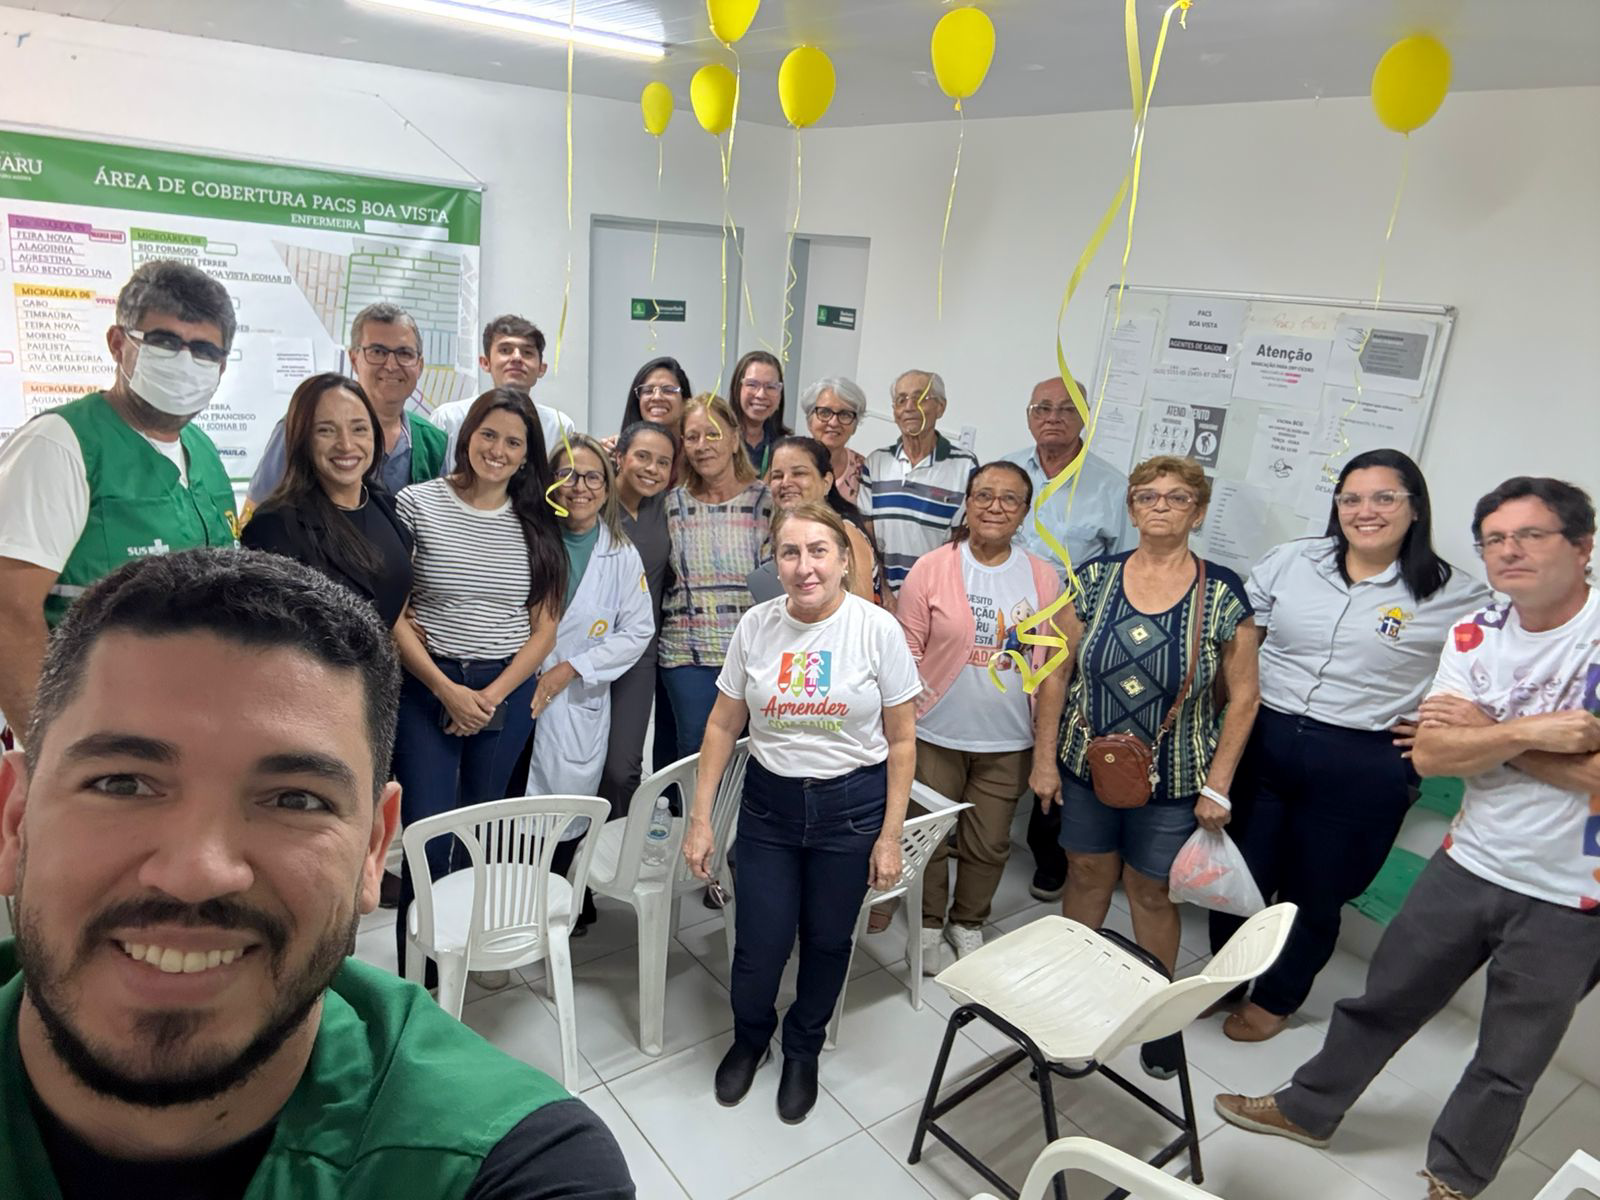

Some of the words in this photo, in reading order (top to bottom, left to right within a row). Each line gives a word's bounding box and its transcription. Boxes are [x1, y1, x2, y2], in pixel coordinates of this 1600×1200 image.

[0, 155, 43, 175] ARU
[94, 166, 152, 191] ÁREA
[158, 177, 186, 195] DE
[191, 181, 307, 209] COBERTURA
[312, 194, 356, 213] PACS
[361, 200, 397, 219] BOA
[400, 205, 449, 224] VISTA
[291, 214, 360, 230] ENFERMEIRA
[17, 231, 44, 240] FEIRA
[47, 233, 74, 243] NOVA
[18, 242, 75, 254] ALAGOINHA
[138, 243, 154, 251] RIO
[155, 245, 198, 255] FORMOSO
[19, 253, 73, 265] AGRESTINA
[19, 262, 39, 272] SÃO
[42, 266, 73, 275] BENTO
[75, 268, 90, 276] DO
[92, 268, 113, 279] UNA
[224, 271, 249, 281] VISTA
[22, 287, 77, 298] MICROÁREA
[22, 299, 48, 308] CABO
[1197, 309, 1212, 318] PACS
[25, 321, 51, 330] FEIRA
[54, 322, 81, 331] NOVA
[1188, 320, 1200, 328] BOA
[1200, 321, 1218, 329] VISTA
[26, 332, 66, 340] MORENO
[27, 342, 71, 351] PAULISTA
[1170, 340, 1194, 350] AGENTES
[64, 354, 103, 362] ALEGRIA
[1256, 343, 1313, 363] Atenção
[46, 364, 89, 372] CARUARU
[211, 413, 256, 421] FRANCISCO
[127, 546, 147, 556] SUS
[760, 695, 850, 719] Aprender
